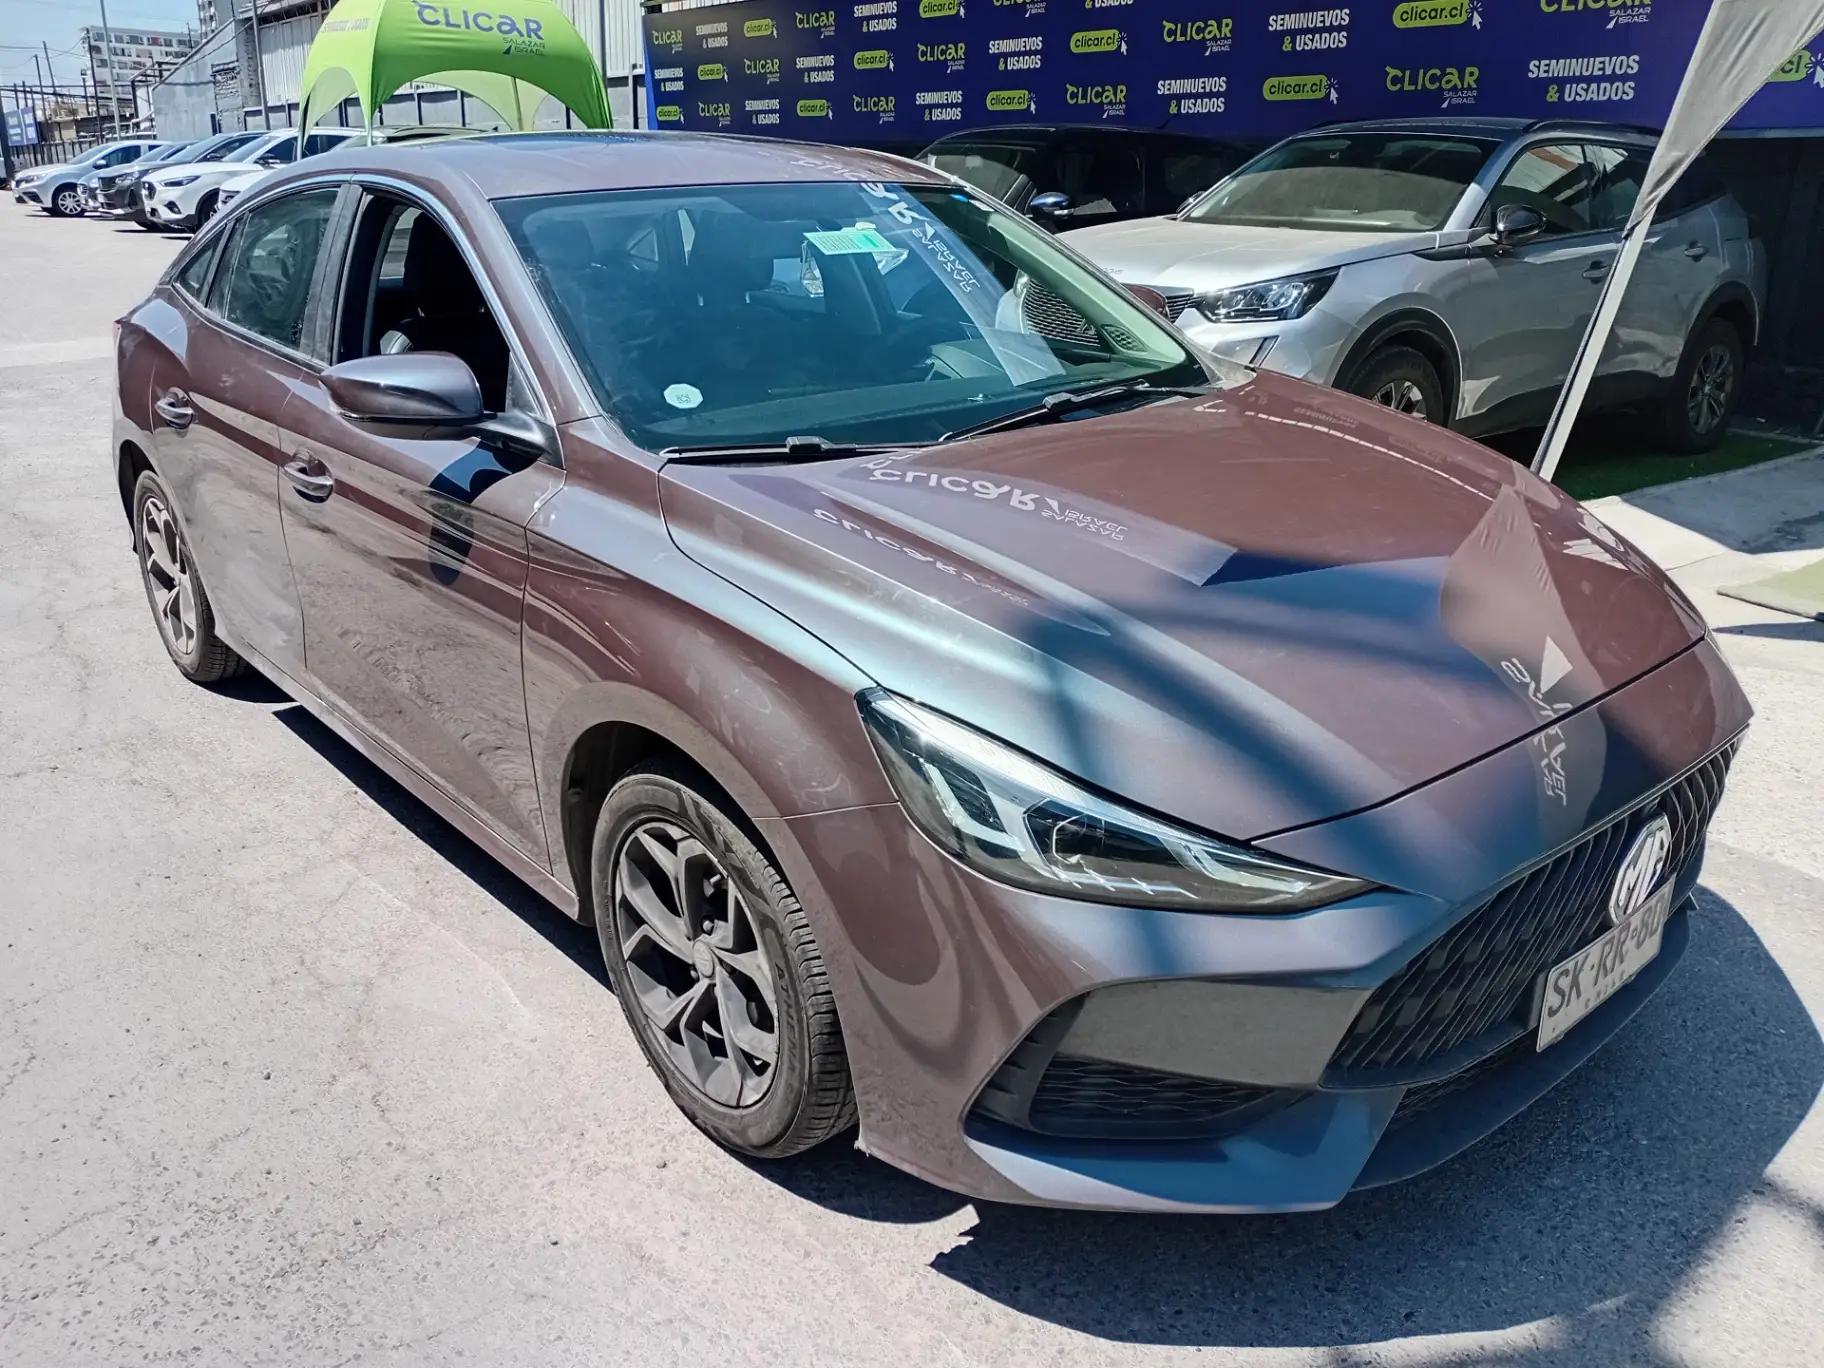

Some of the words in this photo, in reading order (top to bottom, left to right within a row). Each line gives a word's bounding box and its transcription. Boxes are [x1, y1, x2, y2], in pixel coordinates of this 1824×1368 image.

[853, 1, 898, 17] SEMINUEVOS
[922, 1, 955, 14] clicar.cl
[1400, 3, 1464, 22] clicar.cl
[1608, 7, 1652, 17] SALAZAR
[869, 17, 897, 32] USADOS
[1268, 8, 1350, 31] SEMINUEVOS
[1618, 15, 1649, 24] ISRAEL
[989, 36, 1043, 54] SEMINUEVOS
[1074, 34, 1117, 49] clicar.cl
[1282, 35, 1292, 51] &
[1295, 31, 1348, 50] USADOS
[796, 55, 835, 69] SEMINUEVOS
[856, 54, 886, 65] clicar.cl
[998, 57, 1005, 71] &
[1007, 55, 1042, 70] USADOS
[1528, 55, 1640, 79] SEMINUEVOS
[810, 70, 835, 83] USADOS
[1157, 77, 1228, 96] SEMINUEVOS
[1268, 78, 1323, 95] clicar.cl
[1443, 90, 1478, 98] SALAZAR
[1546, 84, 1559, 102] &
[1564, 82, 1636, 102] USADOS
[915, 90, 963, 105] SEMINUEVOS
[989, 93, 1027, 106] clicar.cl
[1169, 100, 1178, 114] &
[1180, 98, 1225, 114] USADOS
[924, 109, 930, 121] &
[931, 107, 962, 120] USADOS
